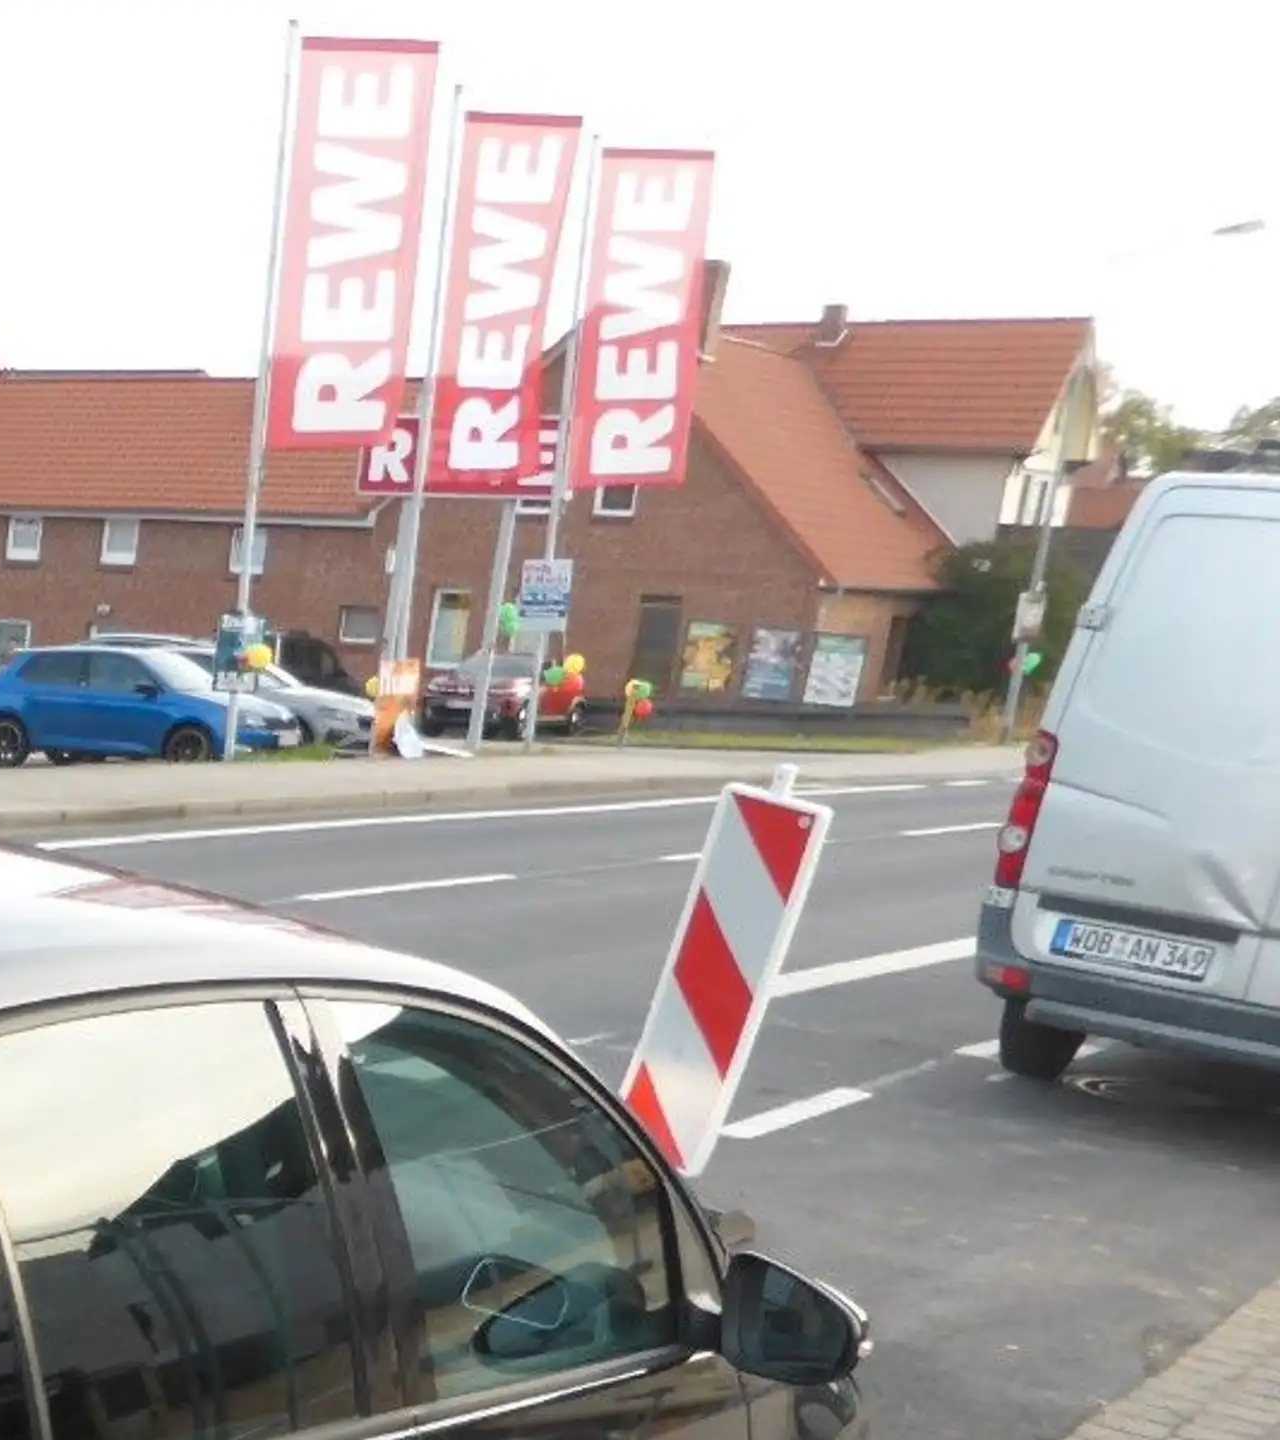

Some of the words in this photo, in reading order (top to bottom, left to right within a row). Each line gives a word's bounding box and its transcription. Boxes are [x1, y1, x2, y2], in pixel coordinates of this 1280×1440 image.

[291, 60, 414, 433] REWE
[448, 133, 564, 471] REWE
[589, 166, 697, 477] REWE
[1068, 924, 1114, 955] WOB
[1128, 938, 1159, 965] AN
[1162, 943, 1207, 974] 349
